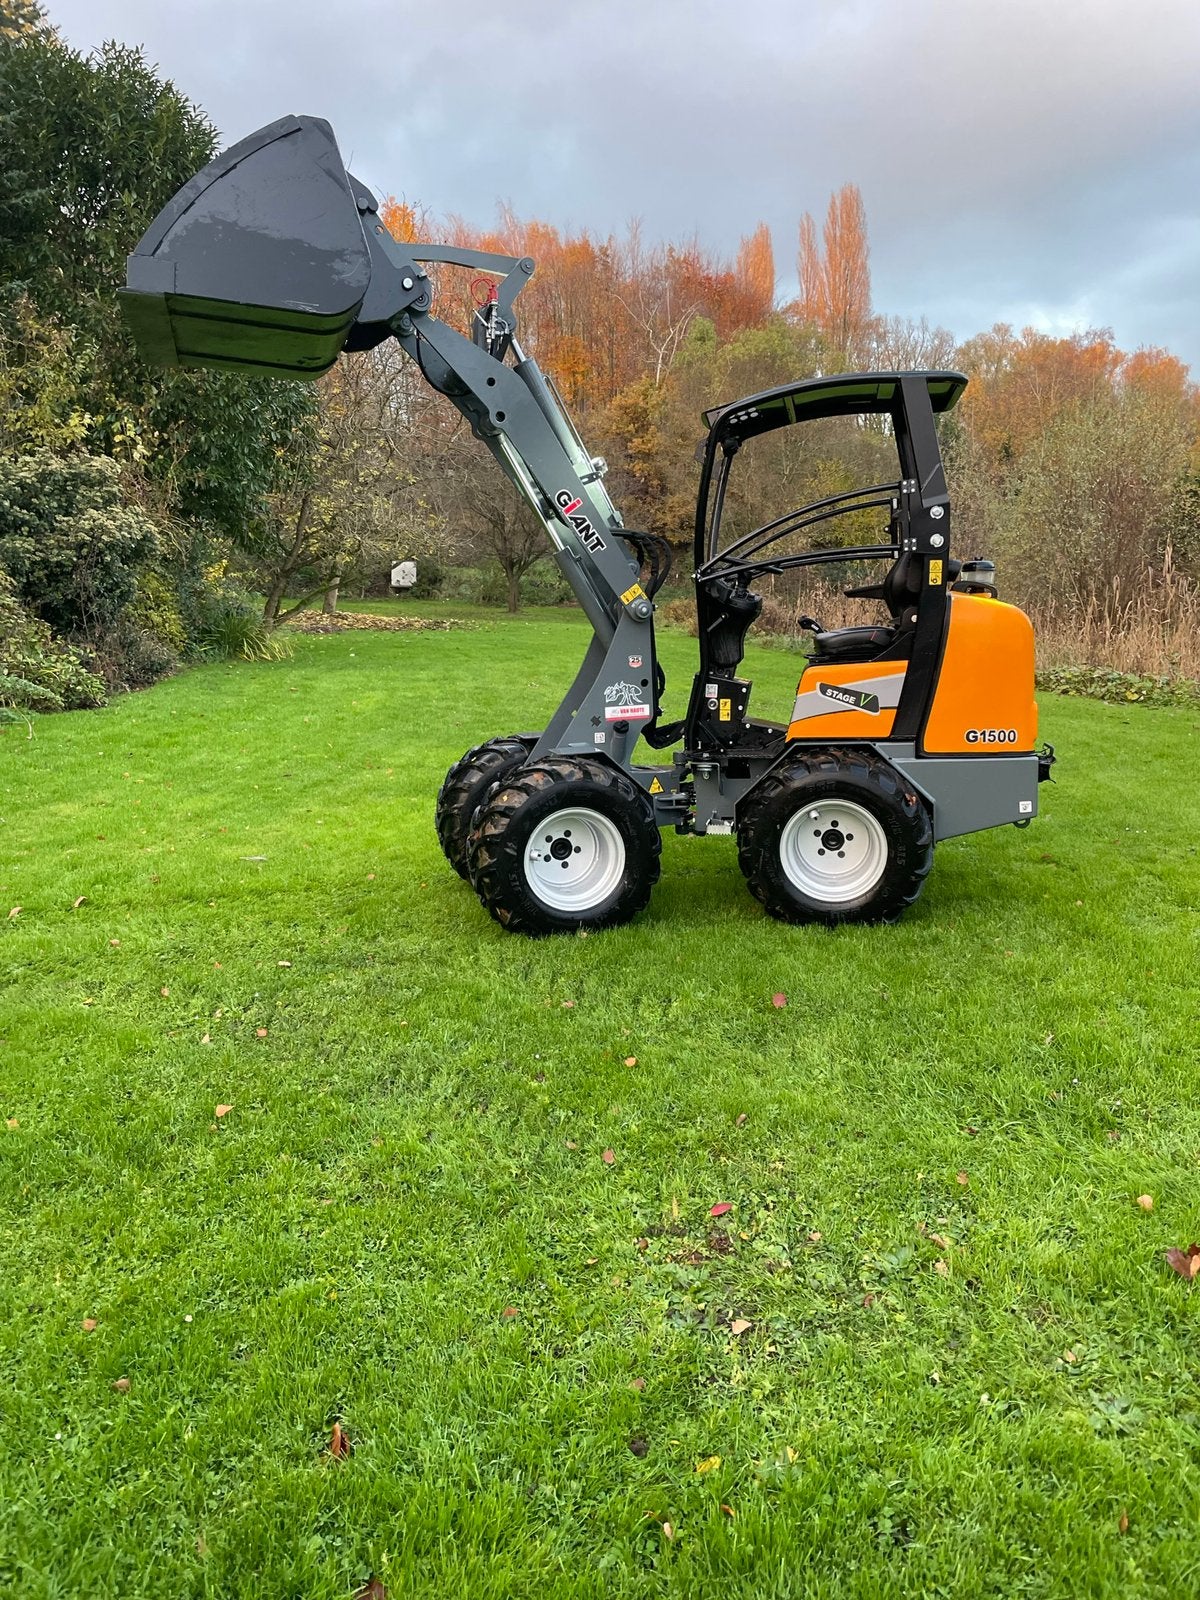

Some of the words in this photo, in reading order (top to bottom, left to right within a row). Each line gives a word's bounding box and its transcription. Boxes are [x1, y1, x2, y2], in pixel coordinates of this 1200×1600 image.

[825, 688, 857, 705] STAGE
[860, 693, 876, 708] V
[965, 729, 1018, 744] G1500
